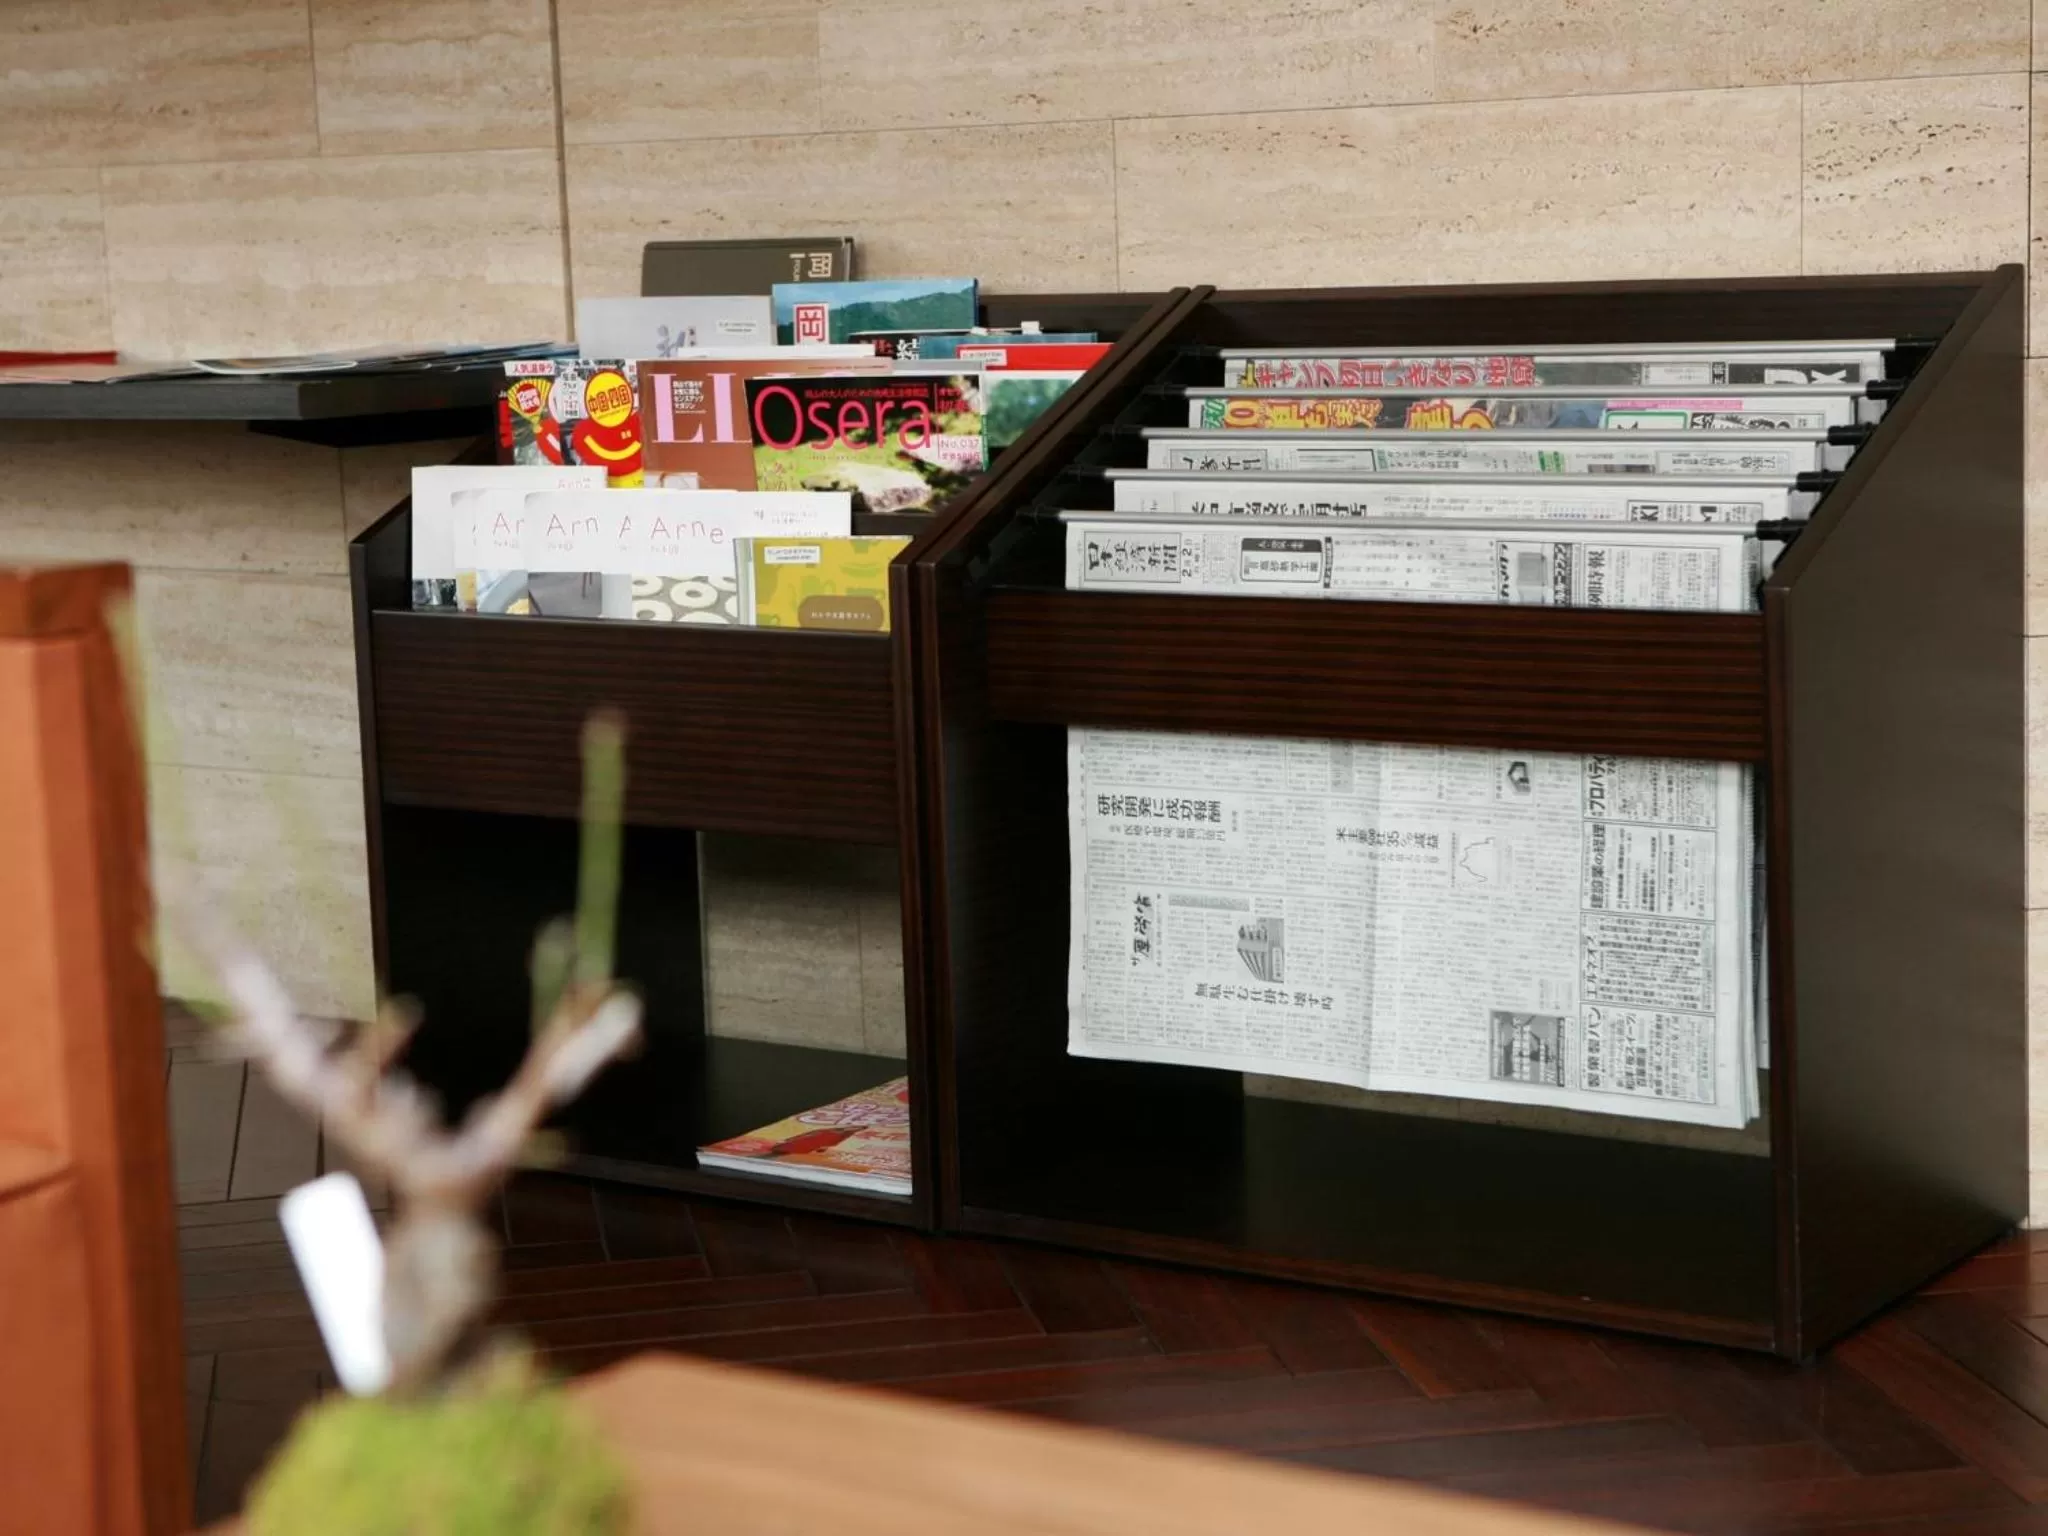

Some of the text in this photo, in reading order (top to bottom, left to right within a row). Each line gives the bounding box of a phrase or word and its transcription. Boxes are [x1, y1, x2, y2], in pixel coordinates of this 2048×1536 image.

[754, 385, 931, 451] Osera
[546, 513, 599, 537] Arn
[650, 516, 724, 545] Arne
[1097, 794, 1222, 823] 研究開発に成功報酬
[1590, 824, 1606, 909] 建設業の経理
